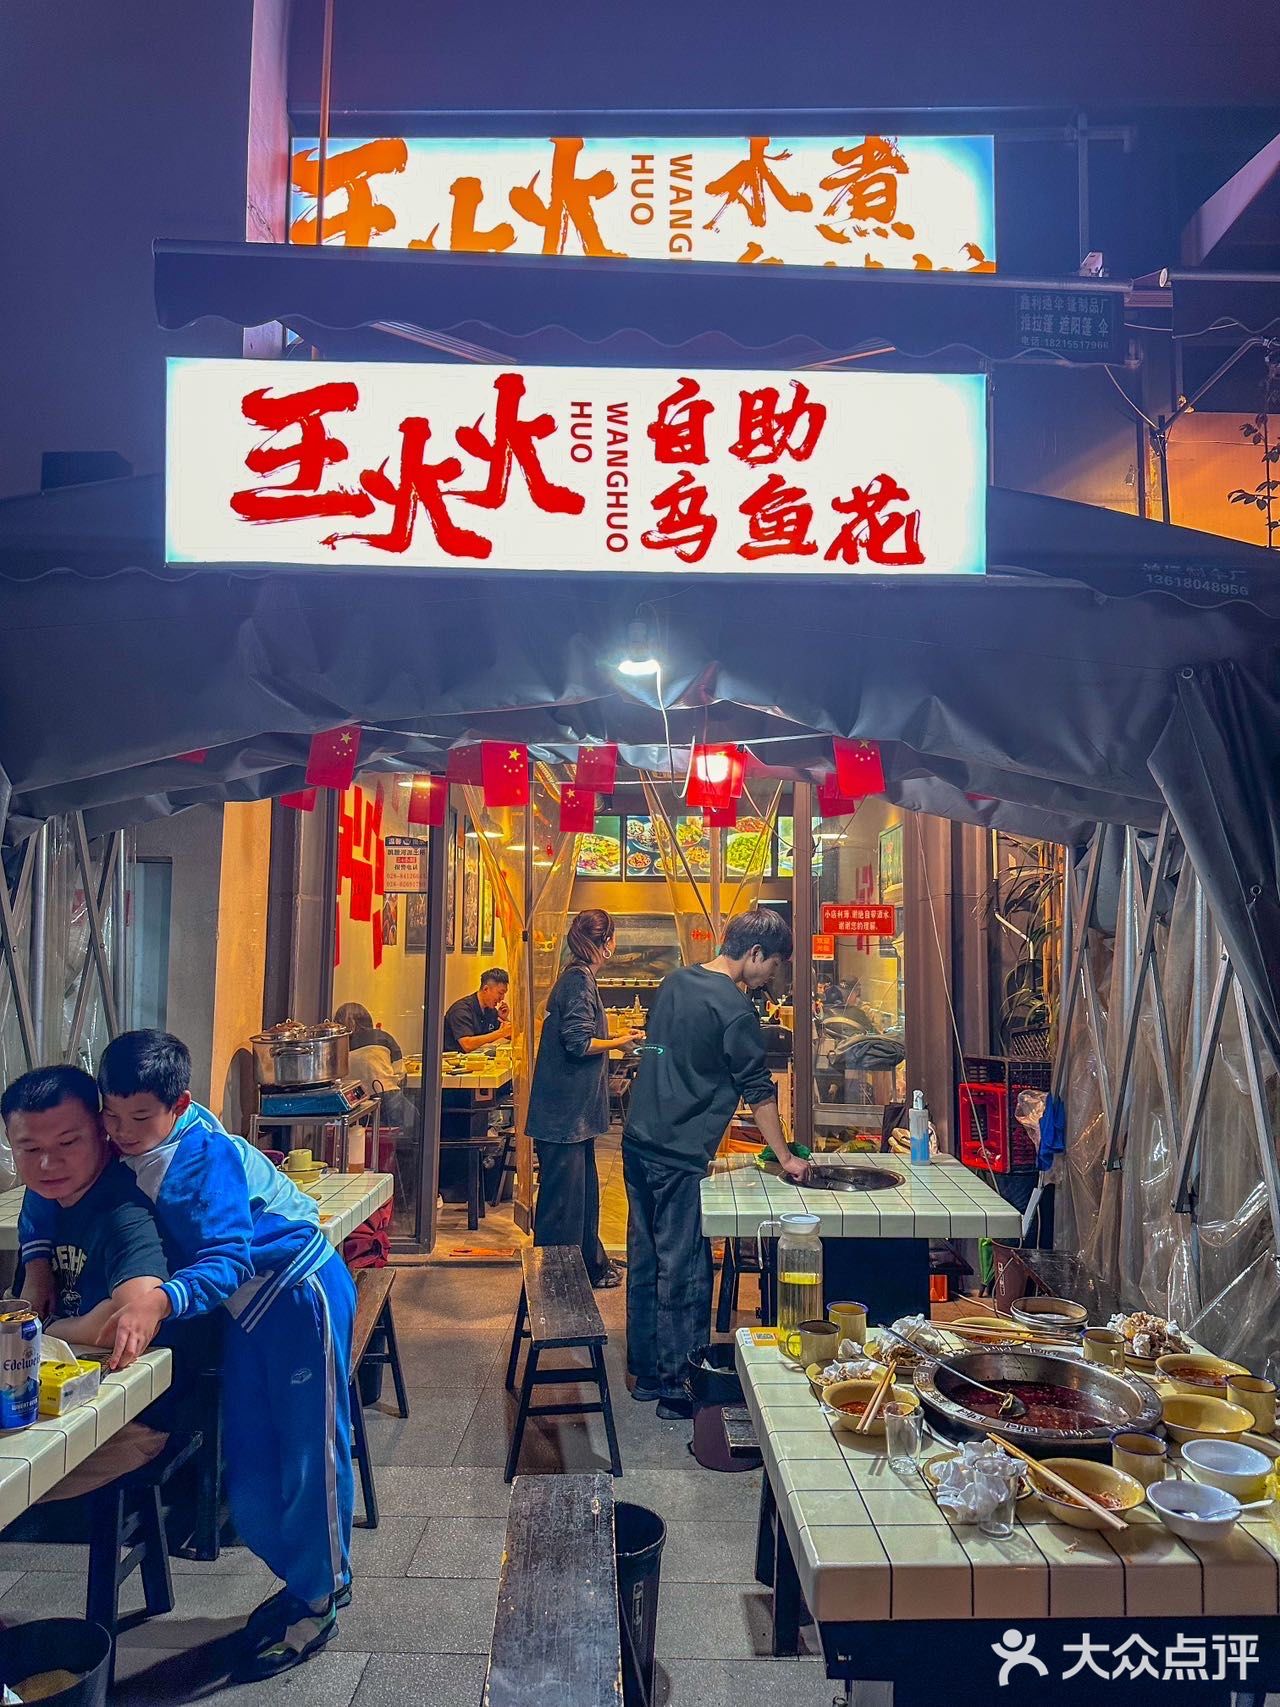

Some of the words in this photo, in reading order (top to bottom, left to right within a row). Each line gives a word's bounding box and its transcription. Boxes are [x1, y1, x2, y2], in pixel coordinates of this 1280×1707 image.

[631, 155, 653, 226] HUO
[669, 155, 693, 258] WANG
[705, 138, 916, 242] 水煮
[230, 373, 586, 559] 王火火
[571, 402, 593, 463] HUO
[647, 377, 827, 466] 自助
[607, 402, 629, 553] WANGHUO
[641, 472, 925, 566] 乌鱼花
